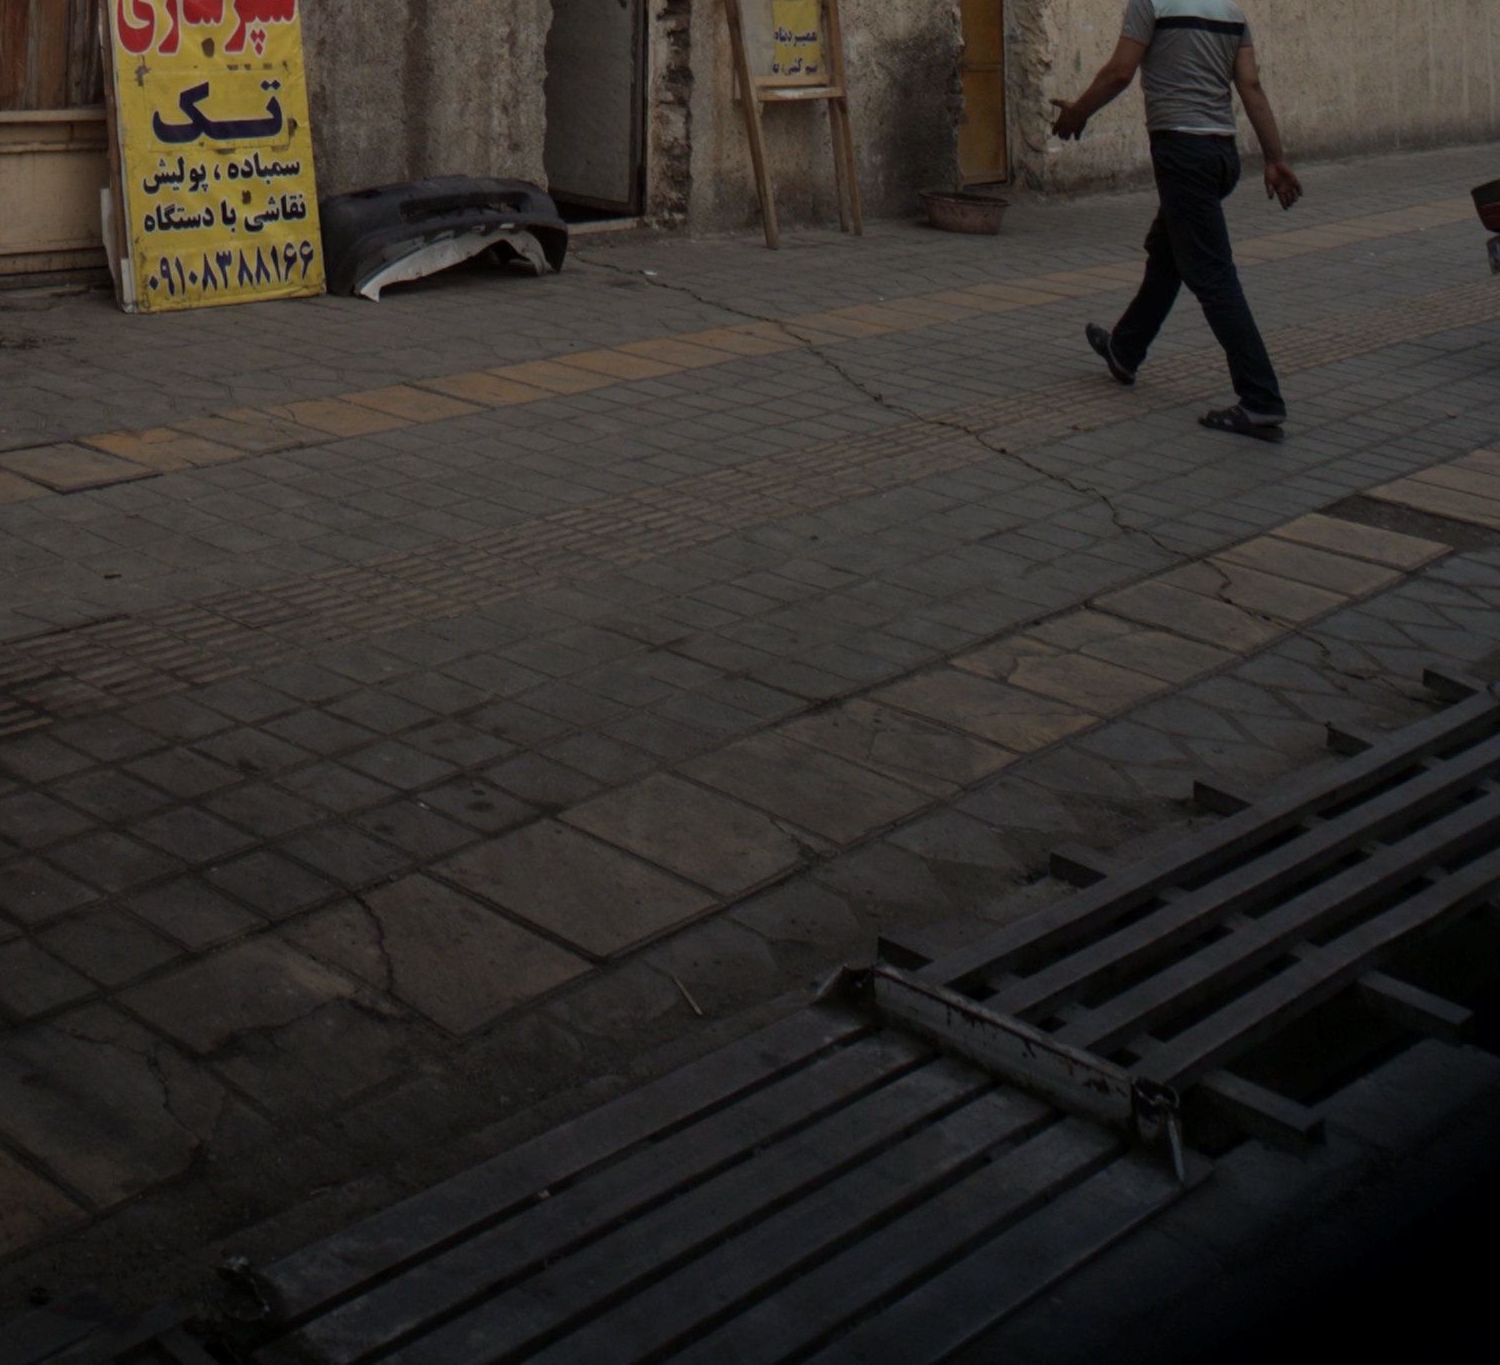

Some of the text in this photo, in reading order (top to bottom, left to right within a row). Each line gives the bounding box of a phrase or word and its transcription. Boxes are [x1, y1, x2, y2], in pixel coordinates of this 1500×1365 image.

[151, 78, 284, 144] تک
[143, 155, 209, 195] پولیش
[227, 151, 301, 185] سمباده
[144, 193, 307, 233] نقاشی با دستگاه
[149, 239, 314, 297] ۰۹۱۰۸۳۸۸۱۶۶
